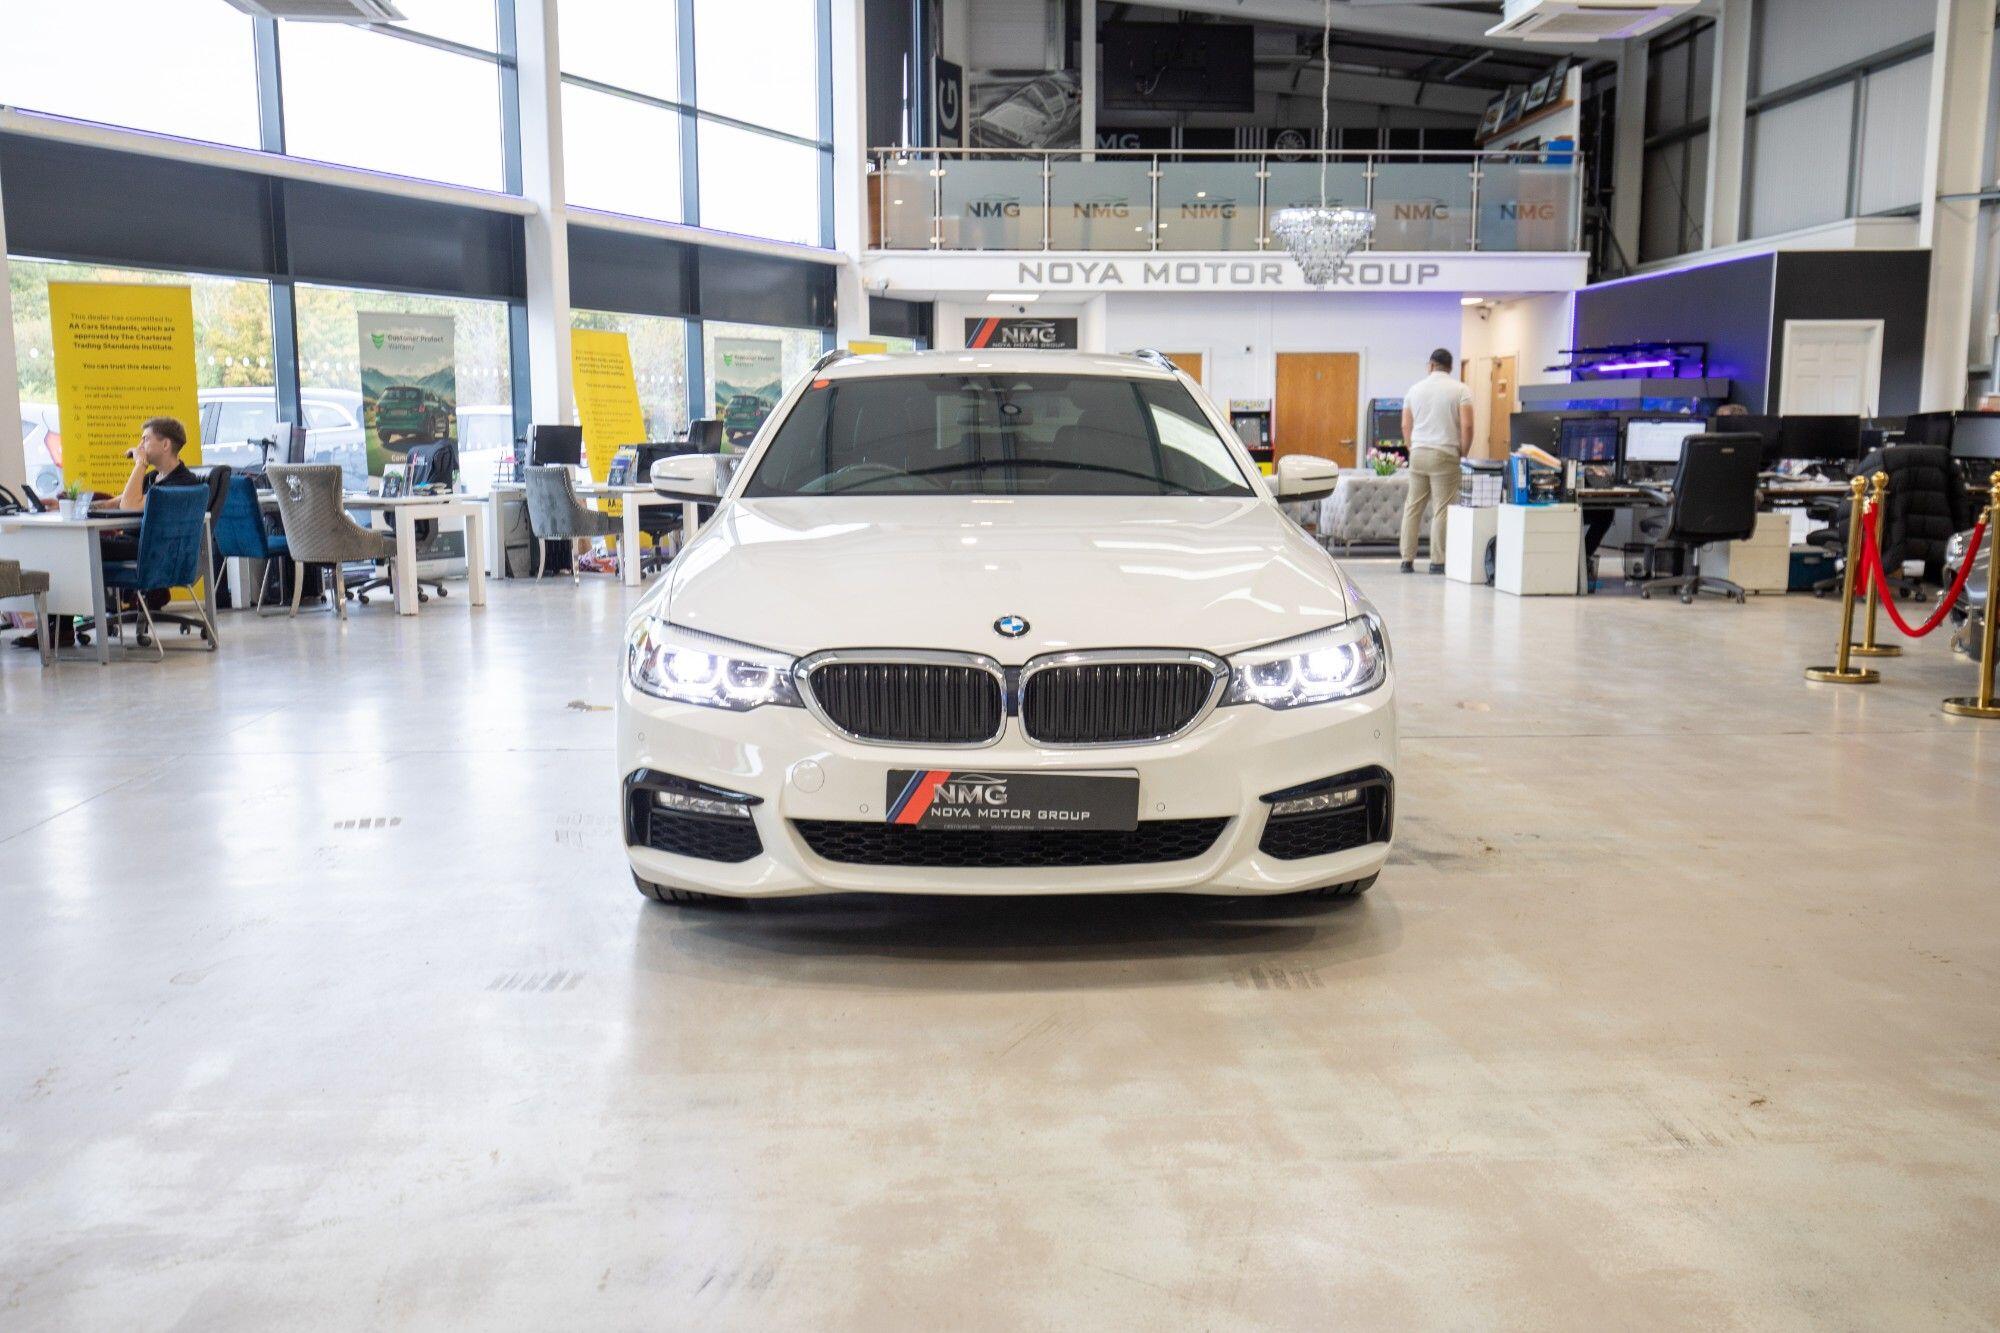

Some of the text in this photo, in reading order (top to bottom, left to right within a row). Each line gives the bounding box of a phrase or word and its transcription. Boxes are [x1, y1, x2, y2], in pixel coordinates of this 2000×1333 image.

[965, 201, 1020, 218] NMG
[1073, 202, 1129, 219] NMG
[1181, 202, 1237, 219] NMG
[1501, 203, 1555, 220] NMG
[1019, 262, 1123, 284] NOYA
[1144, 262, 1282, 284] MOTOR
[100, 324, 139, 332] Standards,
[1002, 327, 1056, 343] NMG
[74, 333, 109, 341] approved
[110, 333, 120, 342] by
[388, 334, 444, 343] Customer Protect
[73, 342, 174, 351] Trading Standards Institute.
[933, 783, 1008, 805] NMG
[931, 807, 1091, 821] NOYA MOTOR GROUP
